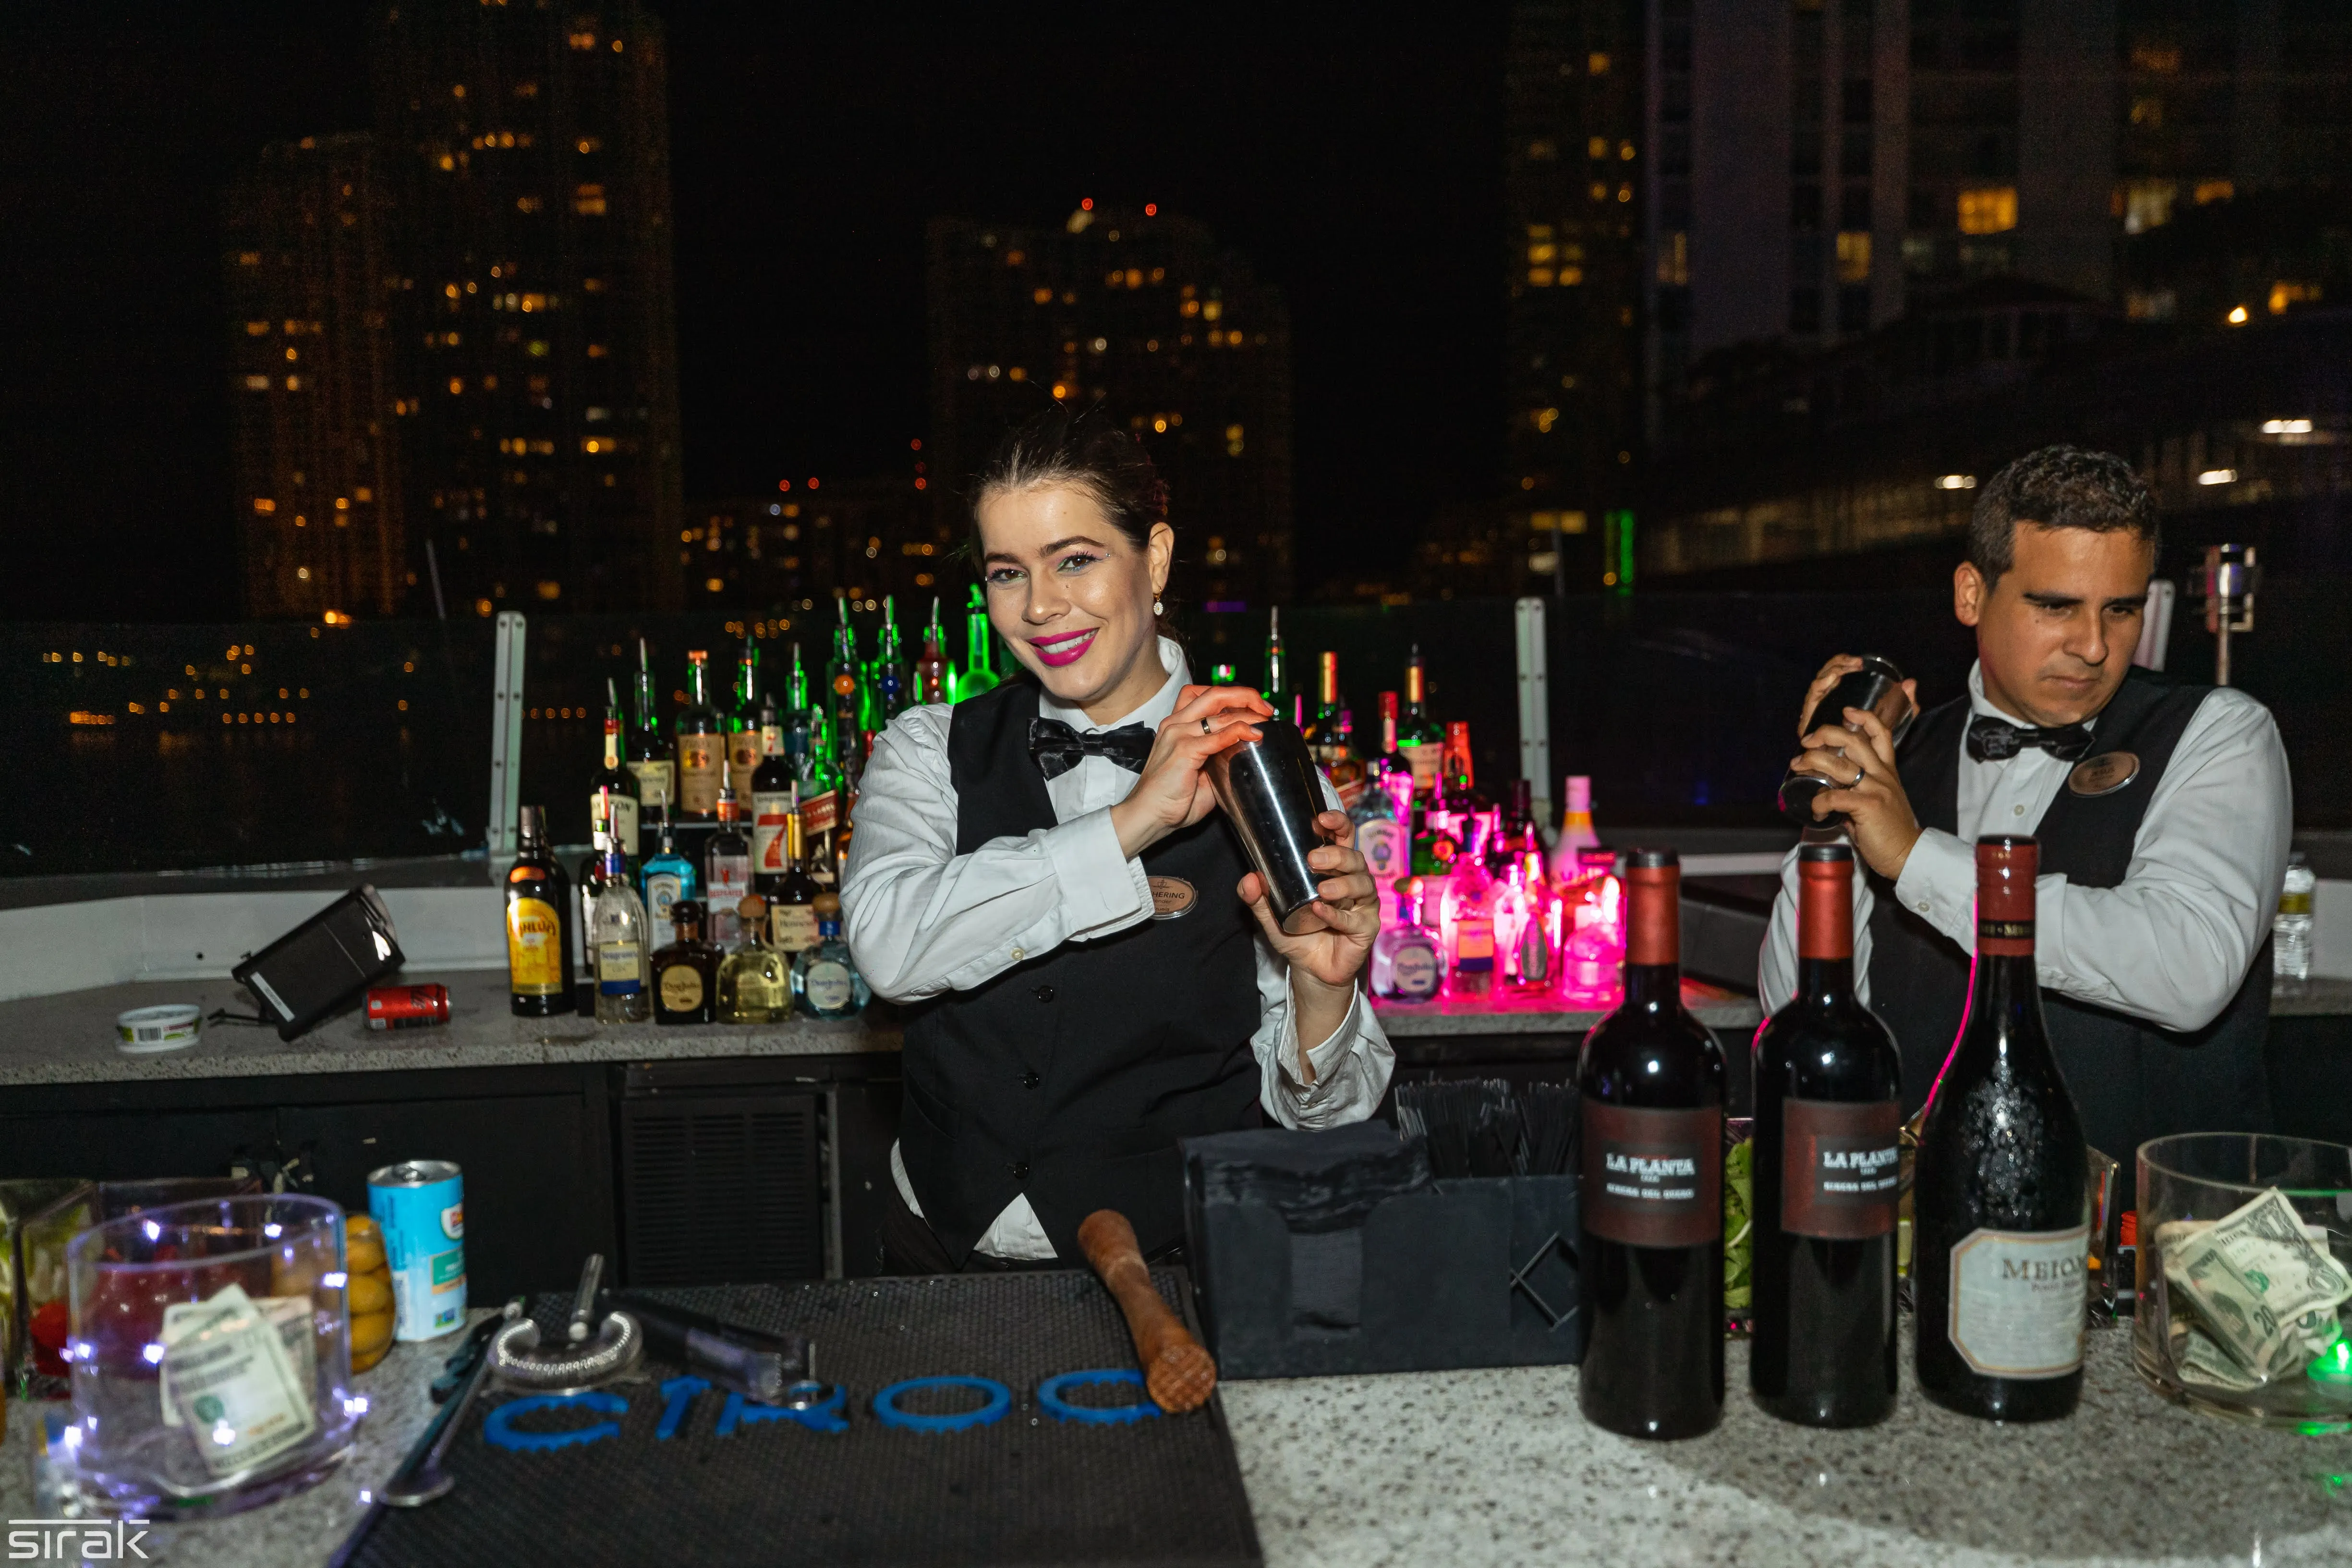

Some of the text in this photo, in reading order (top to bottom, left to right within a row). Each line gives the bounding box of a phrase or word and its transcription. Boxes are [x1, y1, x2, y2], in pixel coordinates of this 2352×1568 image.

[757, 814, 788, 867] 7
[1606, 1153, 1696, 1176] LA PLANTA
[1824, 1151, 1848, 1168] LA
[2253, 1304, 2278, 1338] 20
